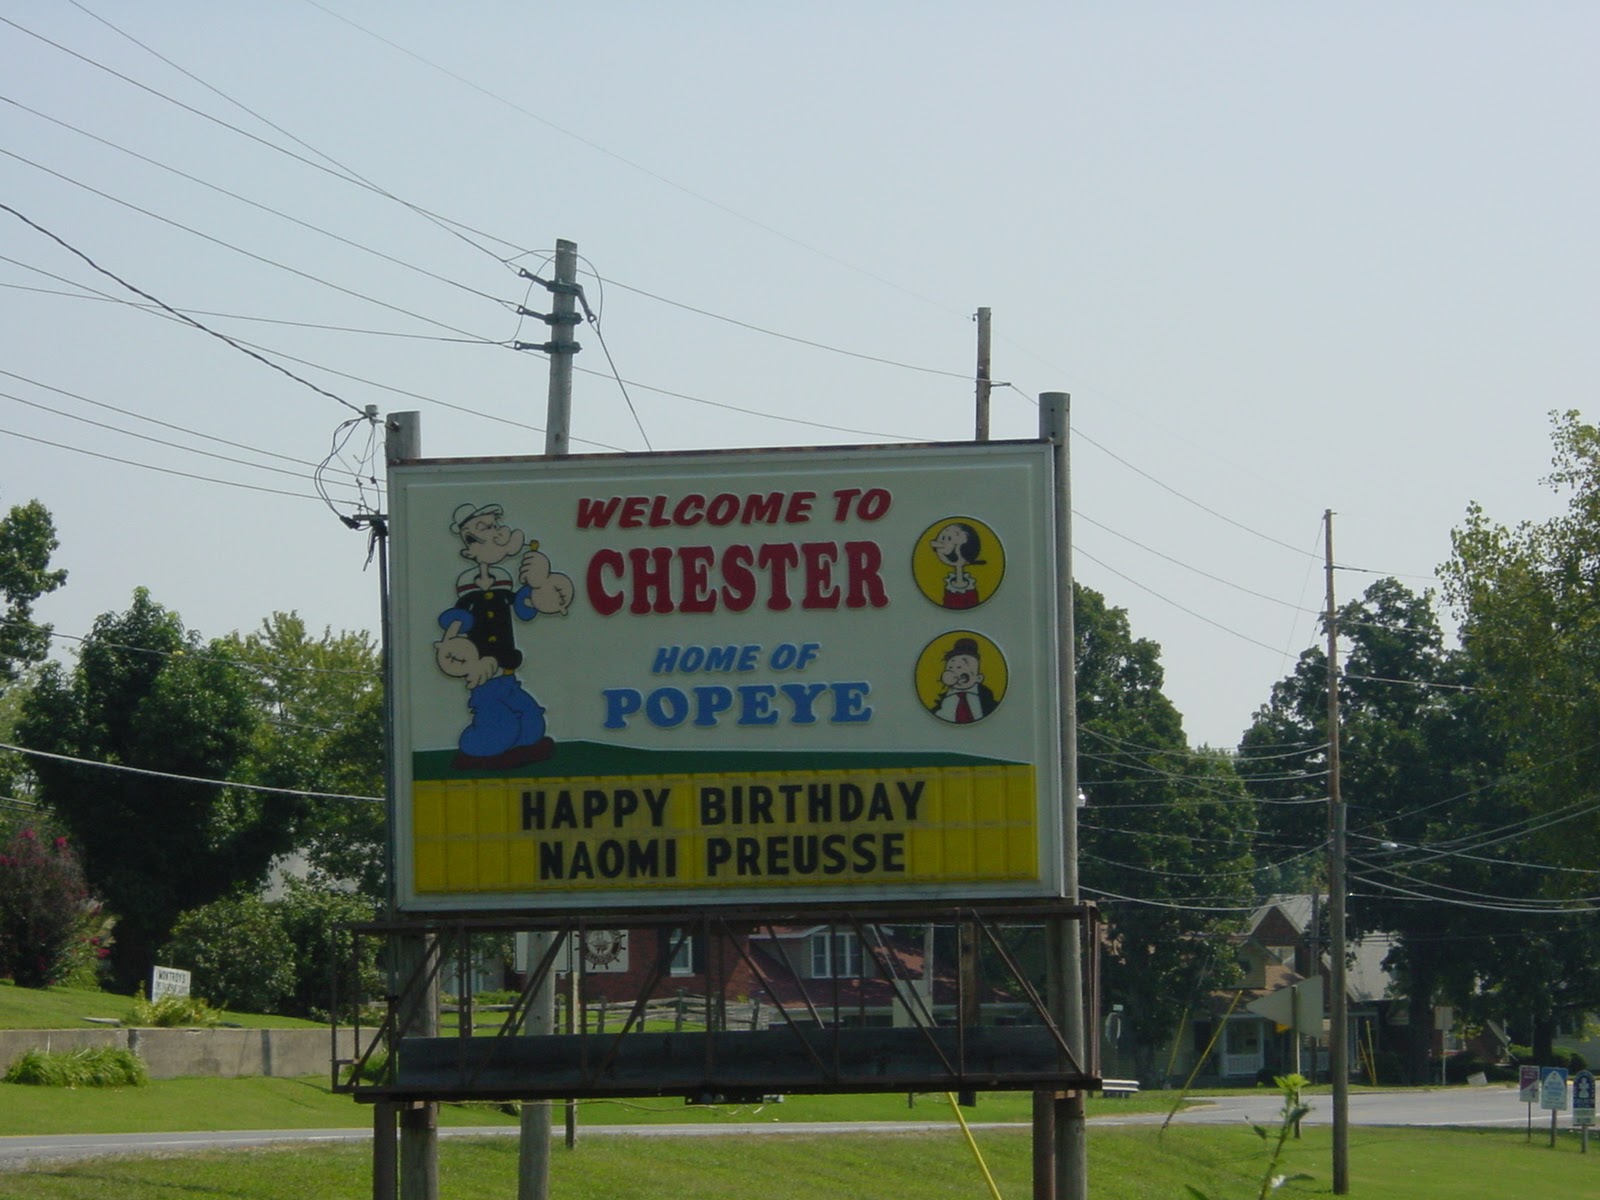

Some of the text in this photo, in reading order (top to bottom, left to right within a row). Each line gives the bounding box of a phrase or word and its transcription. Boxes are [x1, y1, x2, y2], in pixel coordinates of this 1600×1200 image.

[577, 488, 892, 529] WELCOME TO
[587, 541, 889, 615] CHESTER
[652, 643, 819, 672] HOME OF
[603, 682, 872, 729] POPEYE
[521, 780, 925, 831] HAPPY BIRTHDAY
[539, 832, 905, 880] NAOMI PREUSSE
